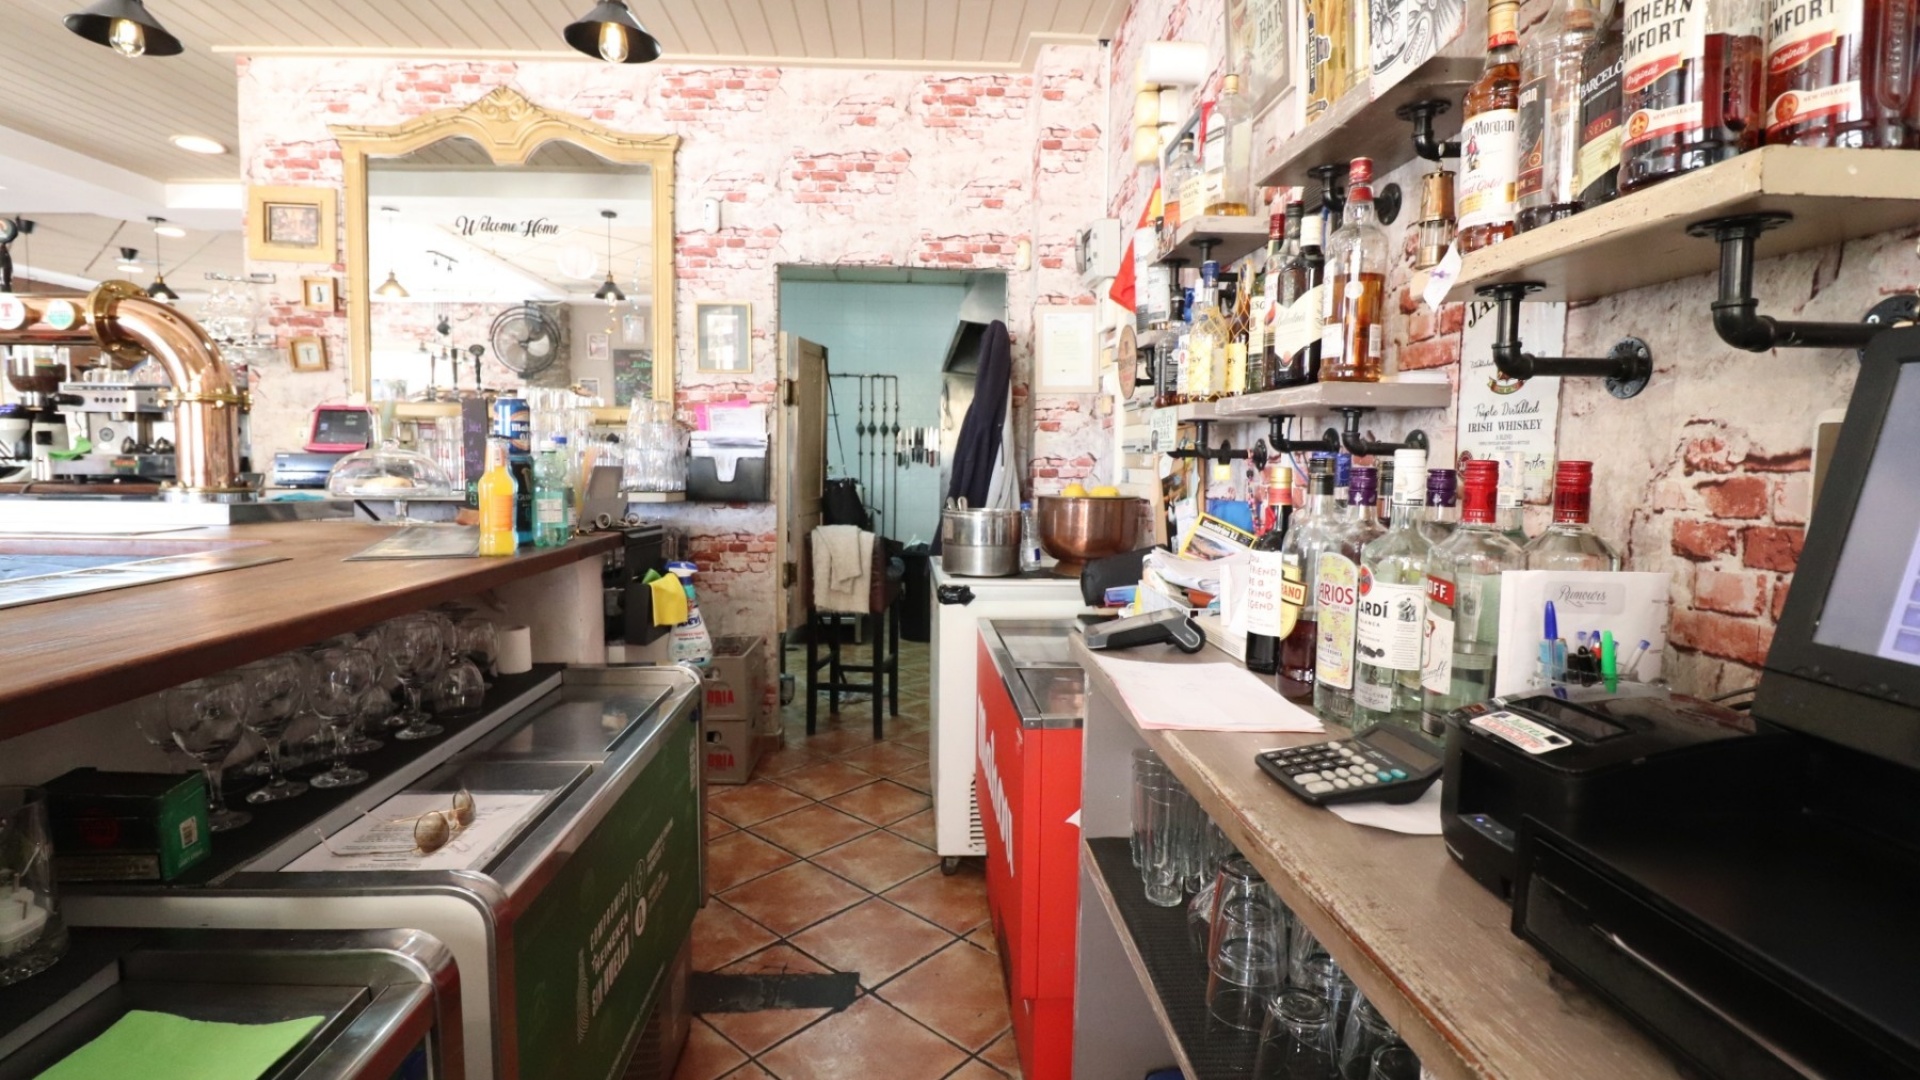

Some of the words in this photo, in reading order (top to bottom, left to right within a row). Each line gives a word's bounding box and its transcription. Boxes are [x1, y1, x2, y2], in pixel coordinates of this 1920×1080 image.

[1623, 18, 1684, 62] OMFORT
[1473, 120, 1514, 135] Morgan
[456, 215, 518, 236] Welcome
[520, 217, 560, 238] Home
[1468, 422, 1493, 433] IRISH
[1498, 419, 1542, 431] WHISKEY
[1319, 583, 1354, 605] ARIOS
[1360, 600, 1389, 618] ARDÍ
